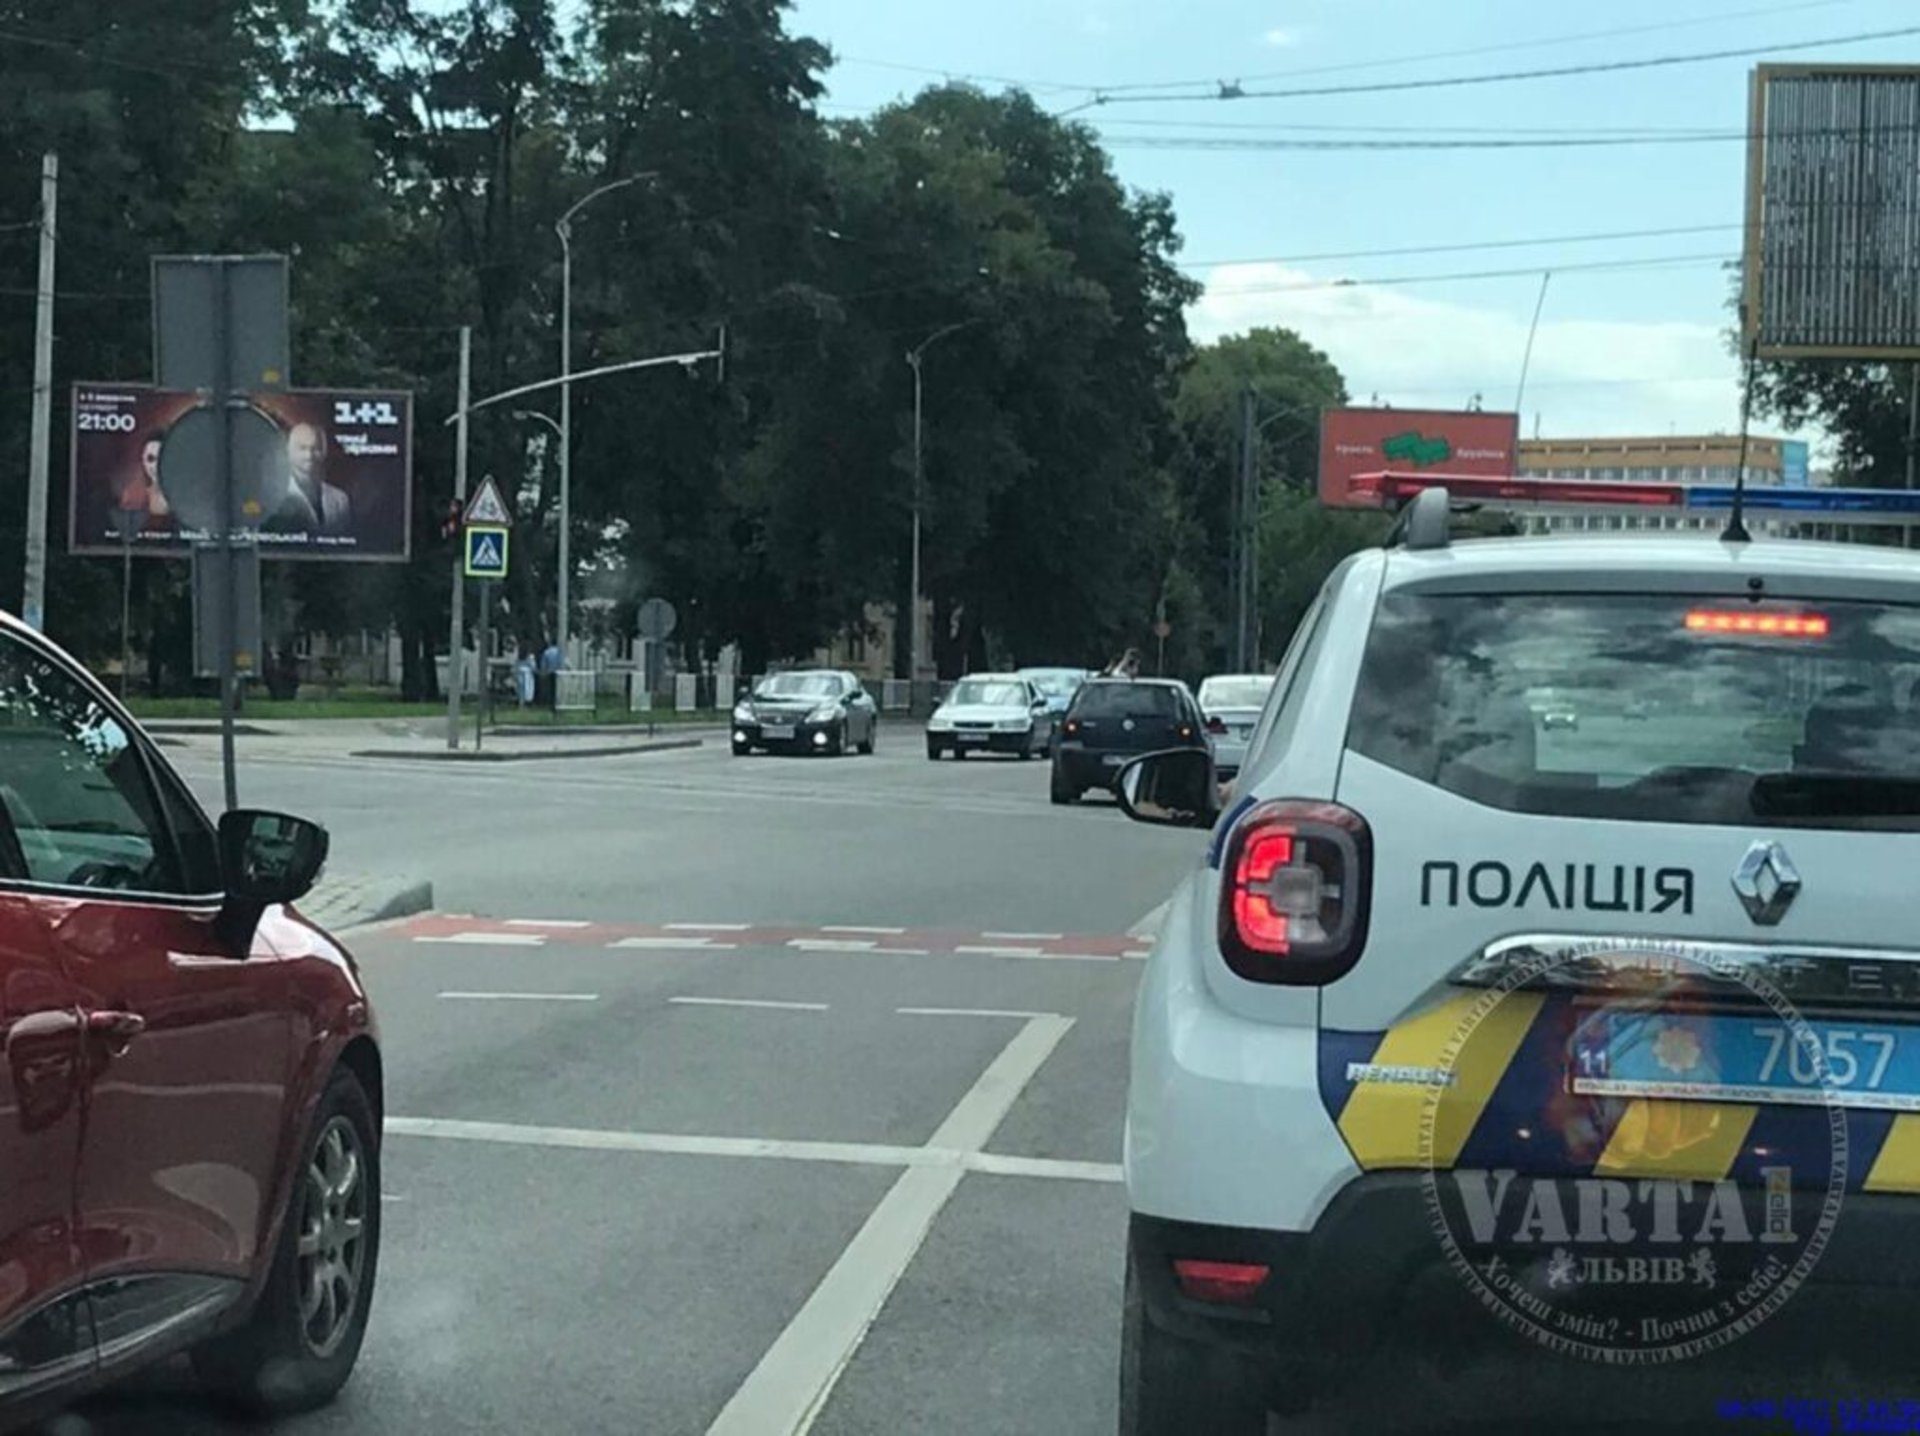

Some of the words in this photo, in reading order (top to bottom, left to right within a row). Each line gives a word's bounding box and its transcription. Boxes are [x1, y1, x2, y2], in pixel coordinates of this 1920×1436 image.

[78, 413, 136, 432] 21:00
[334, 402, 398, 424] 1+1
[1420, 861, 1694, 914] ПОЛІЦІЯ
[1580, 1049, 1606, 1075] 11
[1752, 1027, 1896, 1088] 7057
